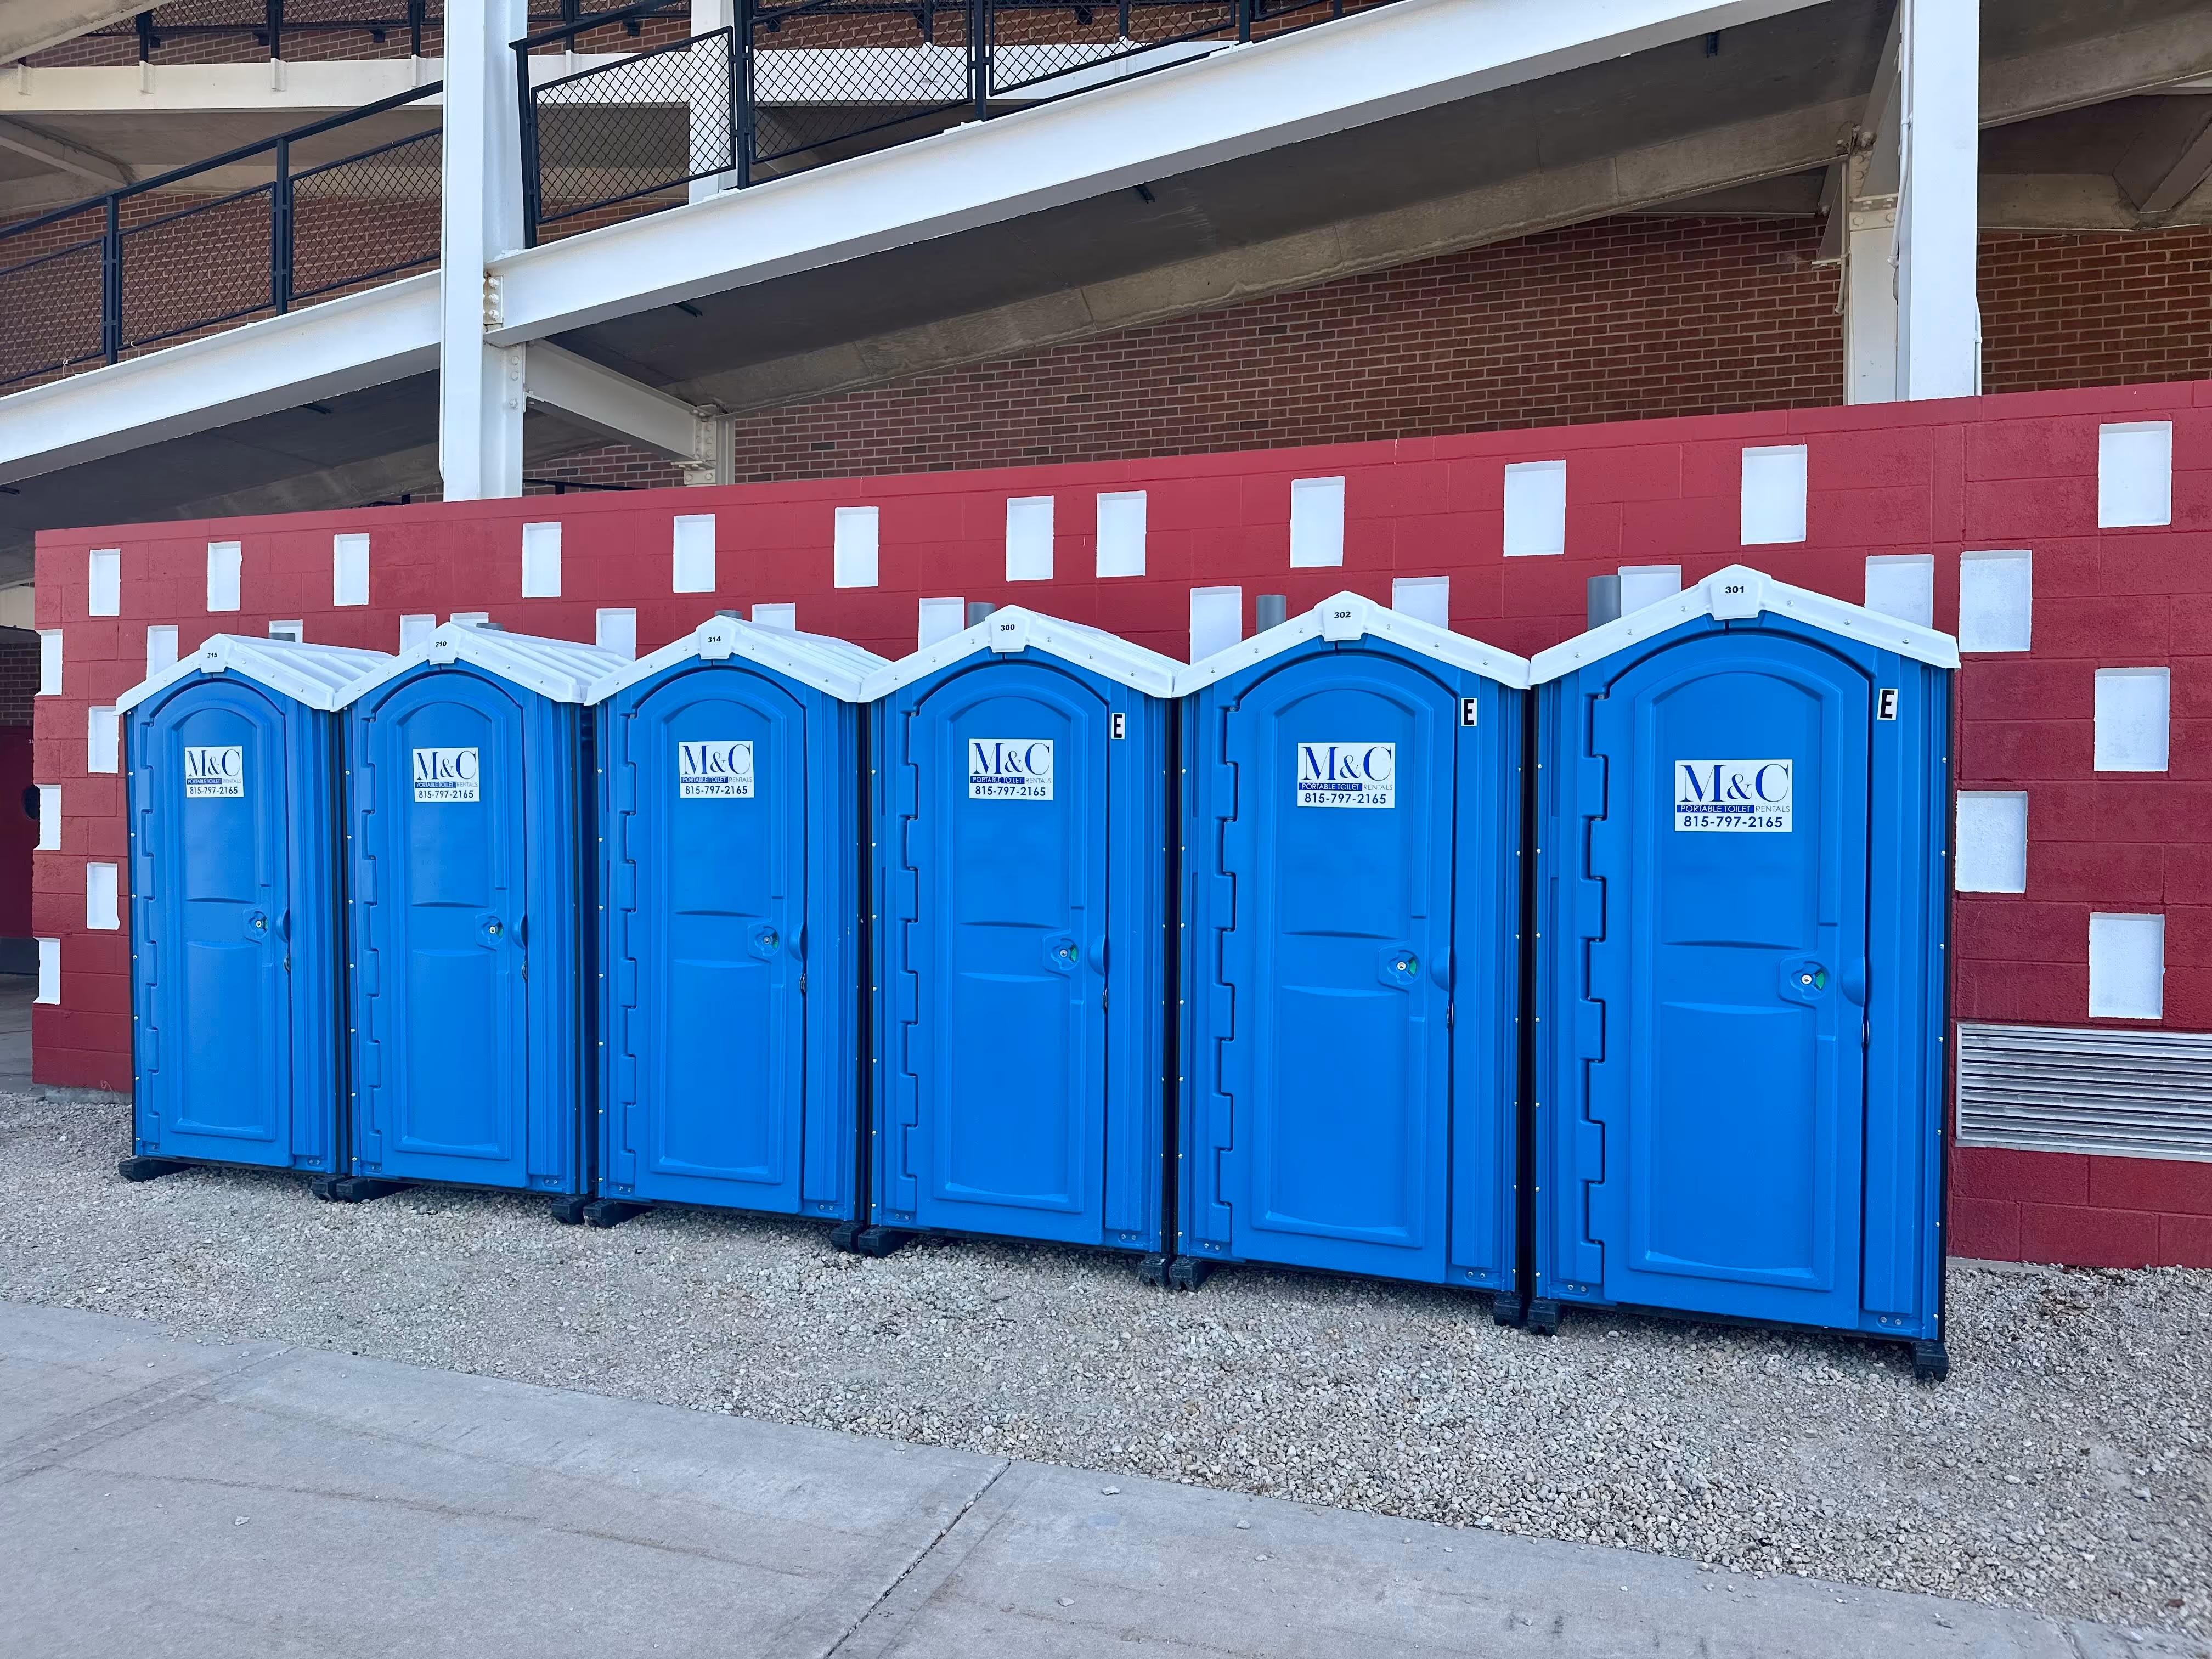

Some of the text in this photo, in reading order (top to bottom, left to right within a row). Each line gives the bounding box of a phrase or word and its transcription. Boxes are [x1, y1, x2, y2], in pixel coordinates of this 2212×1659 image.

[1725, 585, 1745, 594] 301
[1463, 699, 1474, 725] E
[1880, 690, 1895, 719] E
[1113, 714, 1122, 738] E
[187, 749, 240, 777] M&C
[415, 751, 476, 780] M&C
[681, 744, 751, 775] M&C
[971, 742, 1050, 775] M&C
[1300, 746, 1392, 781] M&C
[190, 786, 238, 794] 815-797-2165
[419, 790, 473, 799] 815-797-2165
[685, 786, 748, 794] 815-797-2165
[975, 786, 1046, 797] 815-797-2165
[1679, 764, 1788, 802] M&C
[1305, 793, 1386, 804] 815-797-2165
[1684, 816, 1782, 827] 815-797-2165
